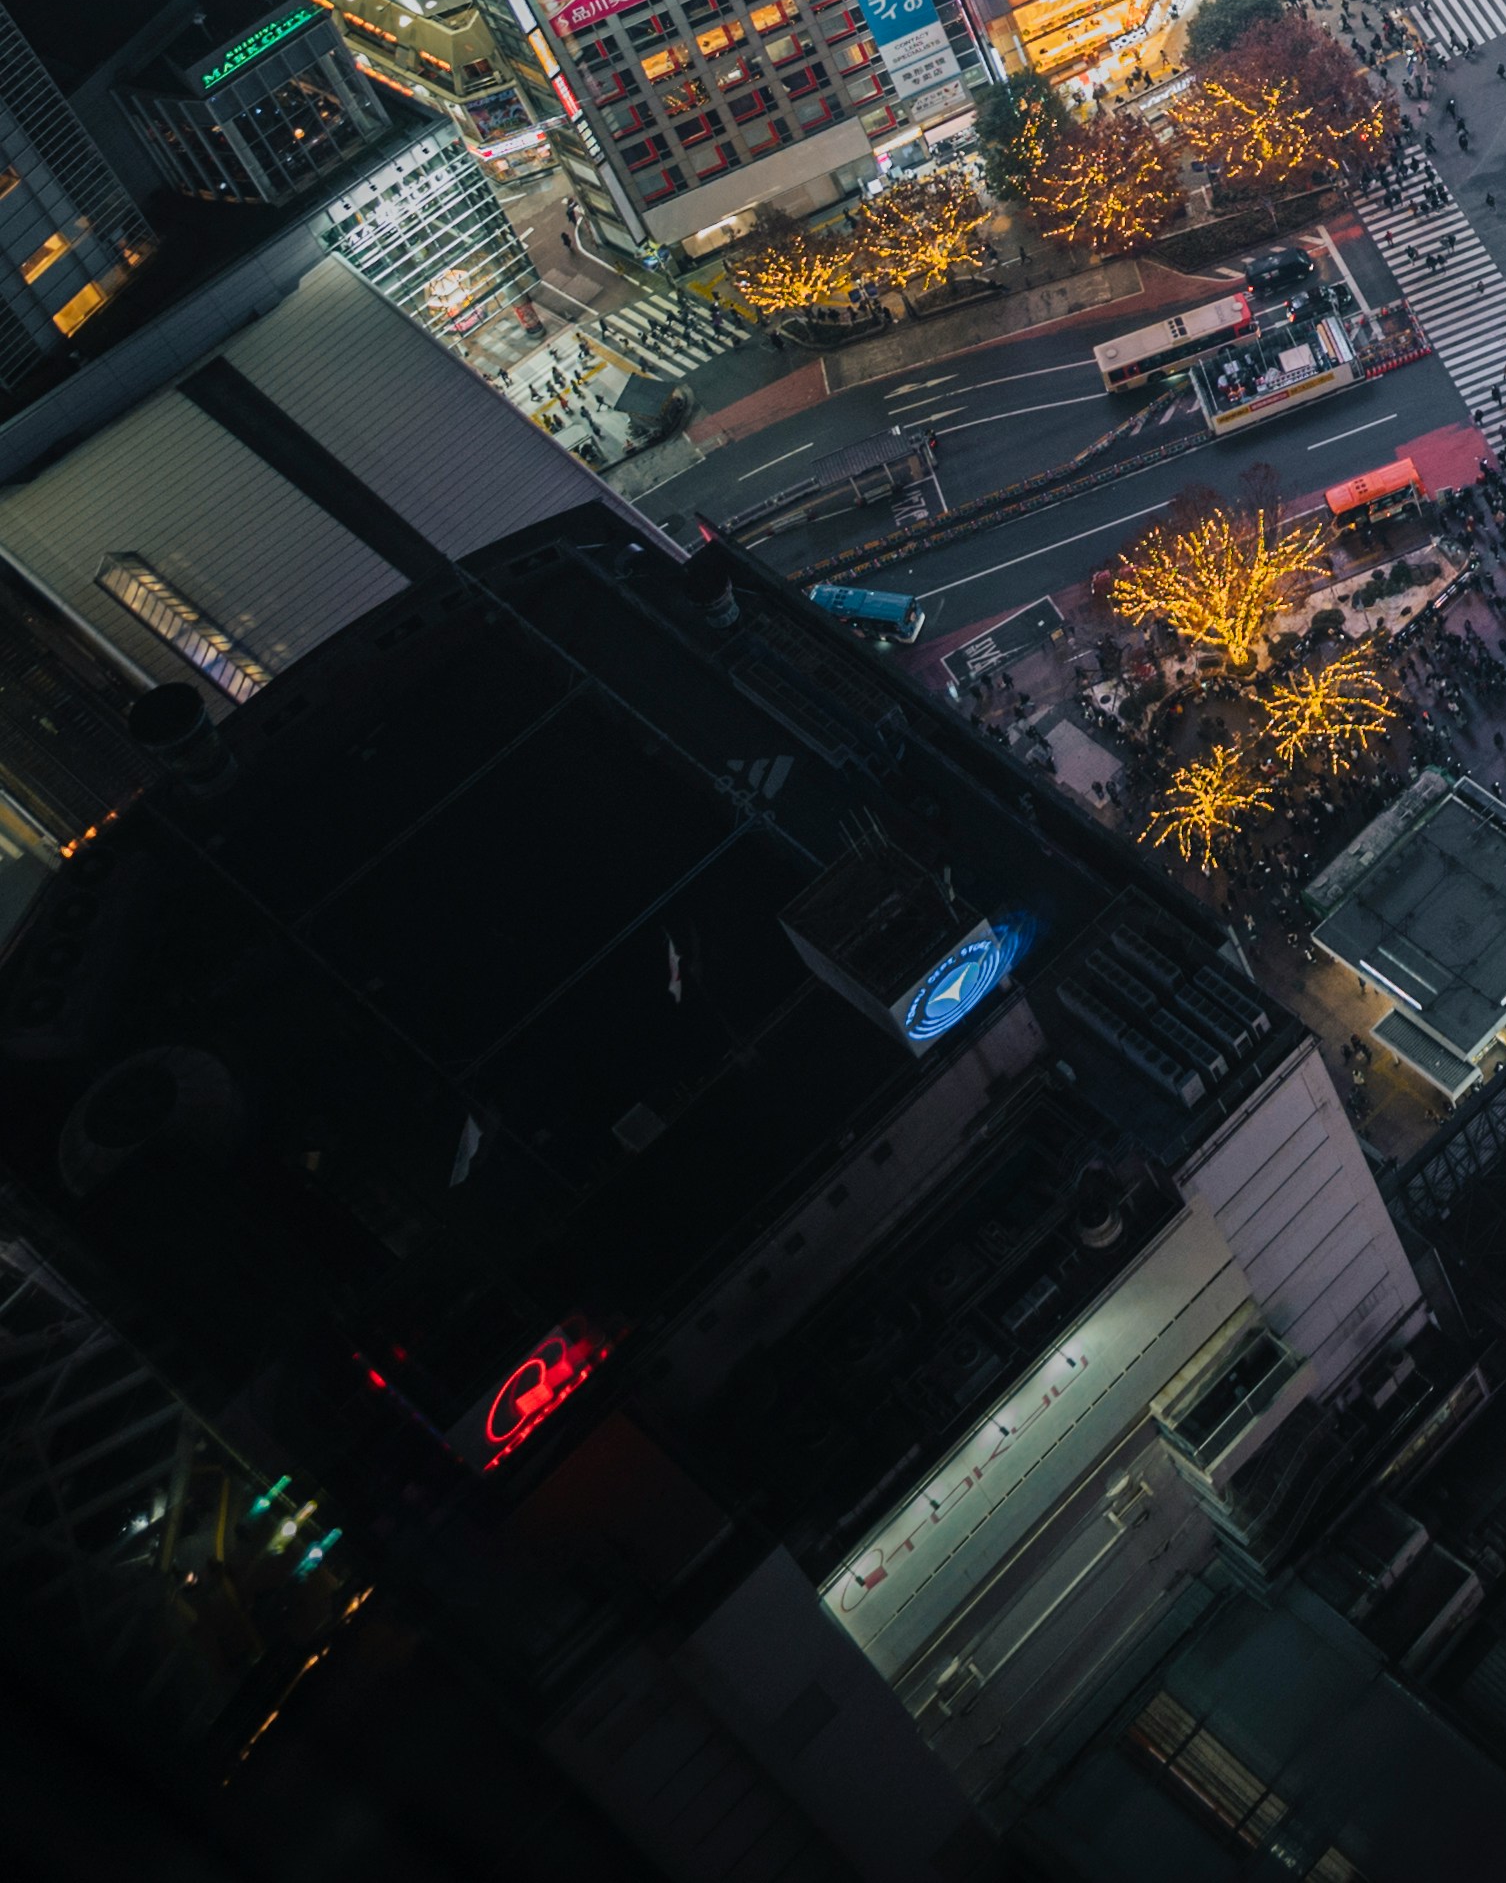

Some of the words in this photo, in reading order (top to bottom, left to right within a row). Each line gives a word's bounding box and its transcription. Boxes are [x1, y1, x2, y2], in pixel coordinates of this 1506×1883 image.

[202, 43, 258, 84] MARK
[261, 9, 310, 45] CITY
[225, 21, 277, 59] SHIBUYA
[891, 39, 941, 64] SPECIALISTS
[894, 30, 930, 50] CONTACT
[903, 40, 924, 53] LENS
[905, 988, 926, 1027] TOKYU
[960, 939, 992, 957] STORE
[884, 1354, 1090, 1552] TOKYU
